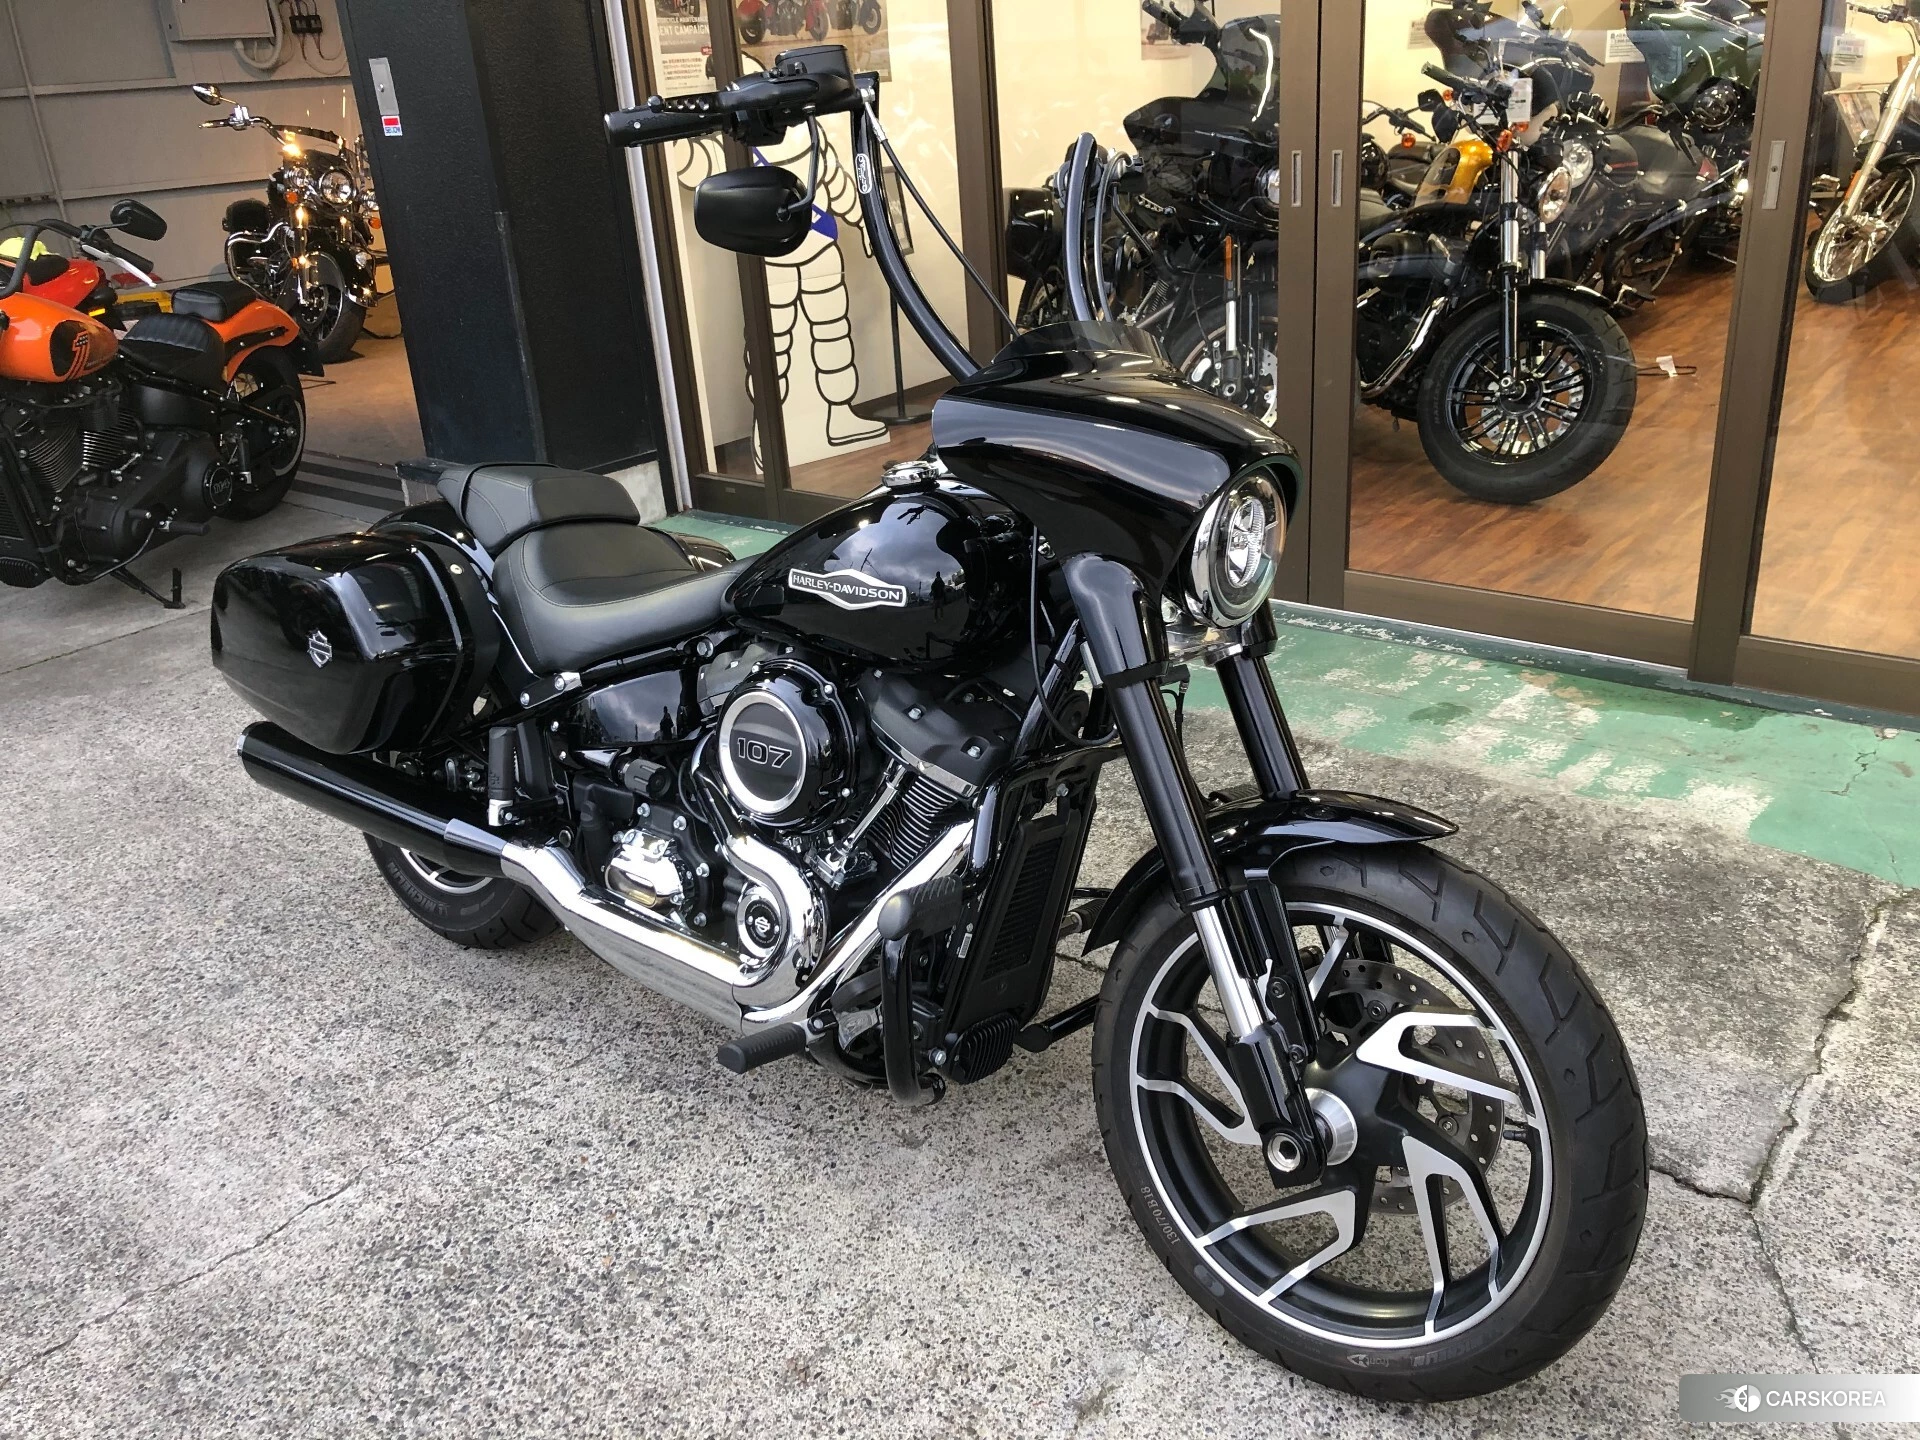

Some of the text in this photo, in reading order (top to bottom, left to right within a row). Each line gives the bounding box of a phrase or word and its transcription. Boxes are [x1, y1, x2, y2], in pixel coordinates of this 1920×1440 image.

[675, 24, 710, 35] CAMPAIGN
[792, 574, 900, 601] HARLEY-DAVIDSON
[737, 737, 793, 769] 107
[387, 861, 437, 912] MICHELIN
[1152, 1209, 1181, 1245] 130/70
[1367, 1356, 1390, 1368] front
